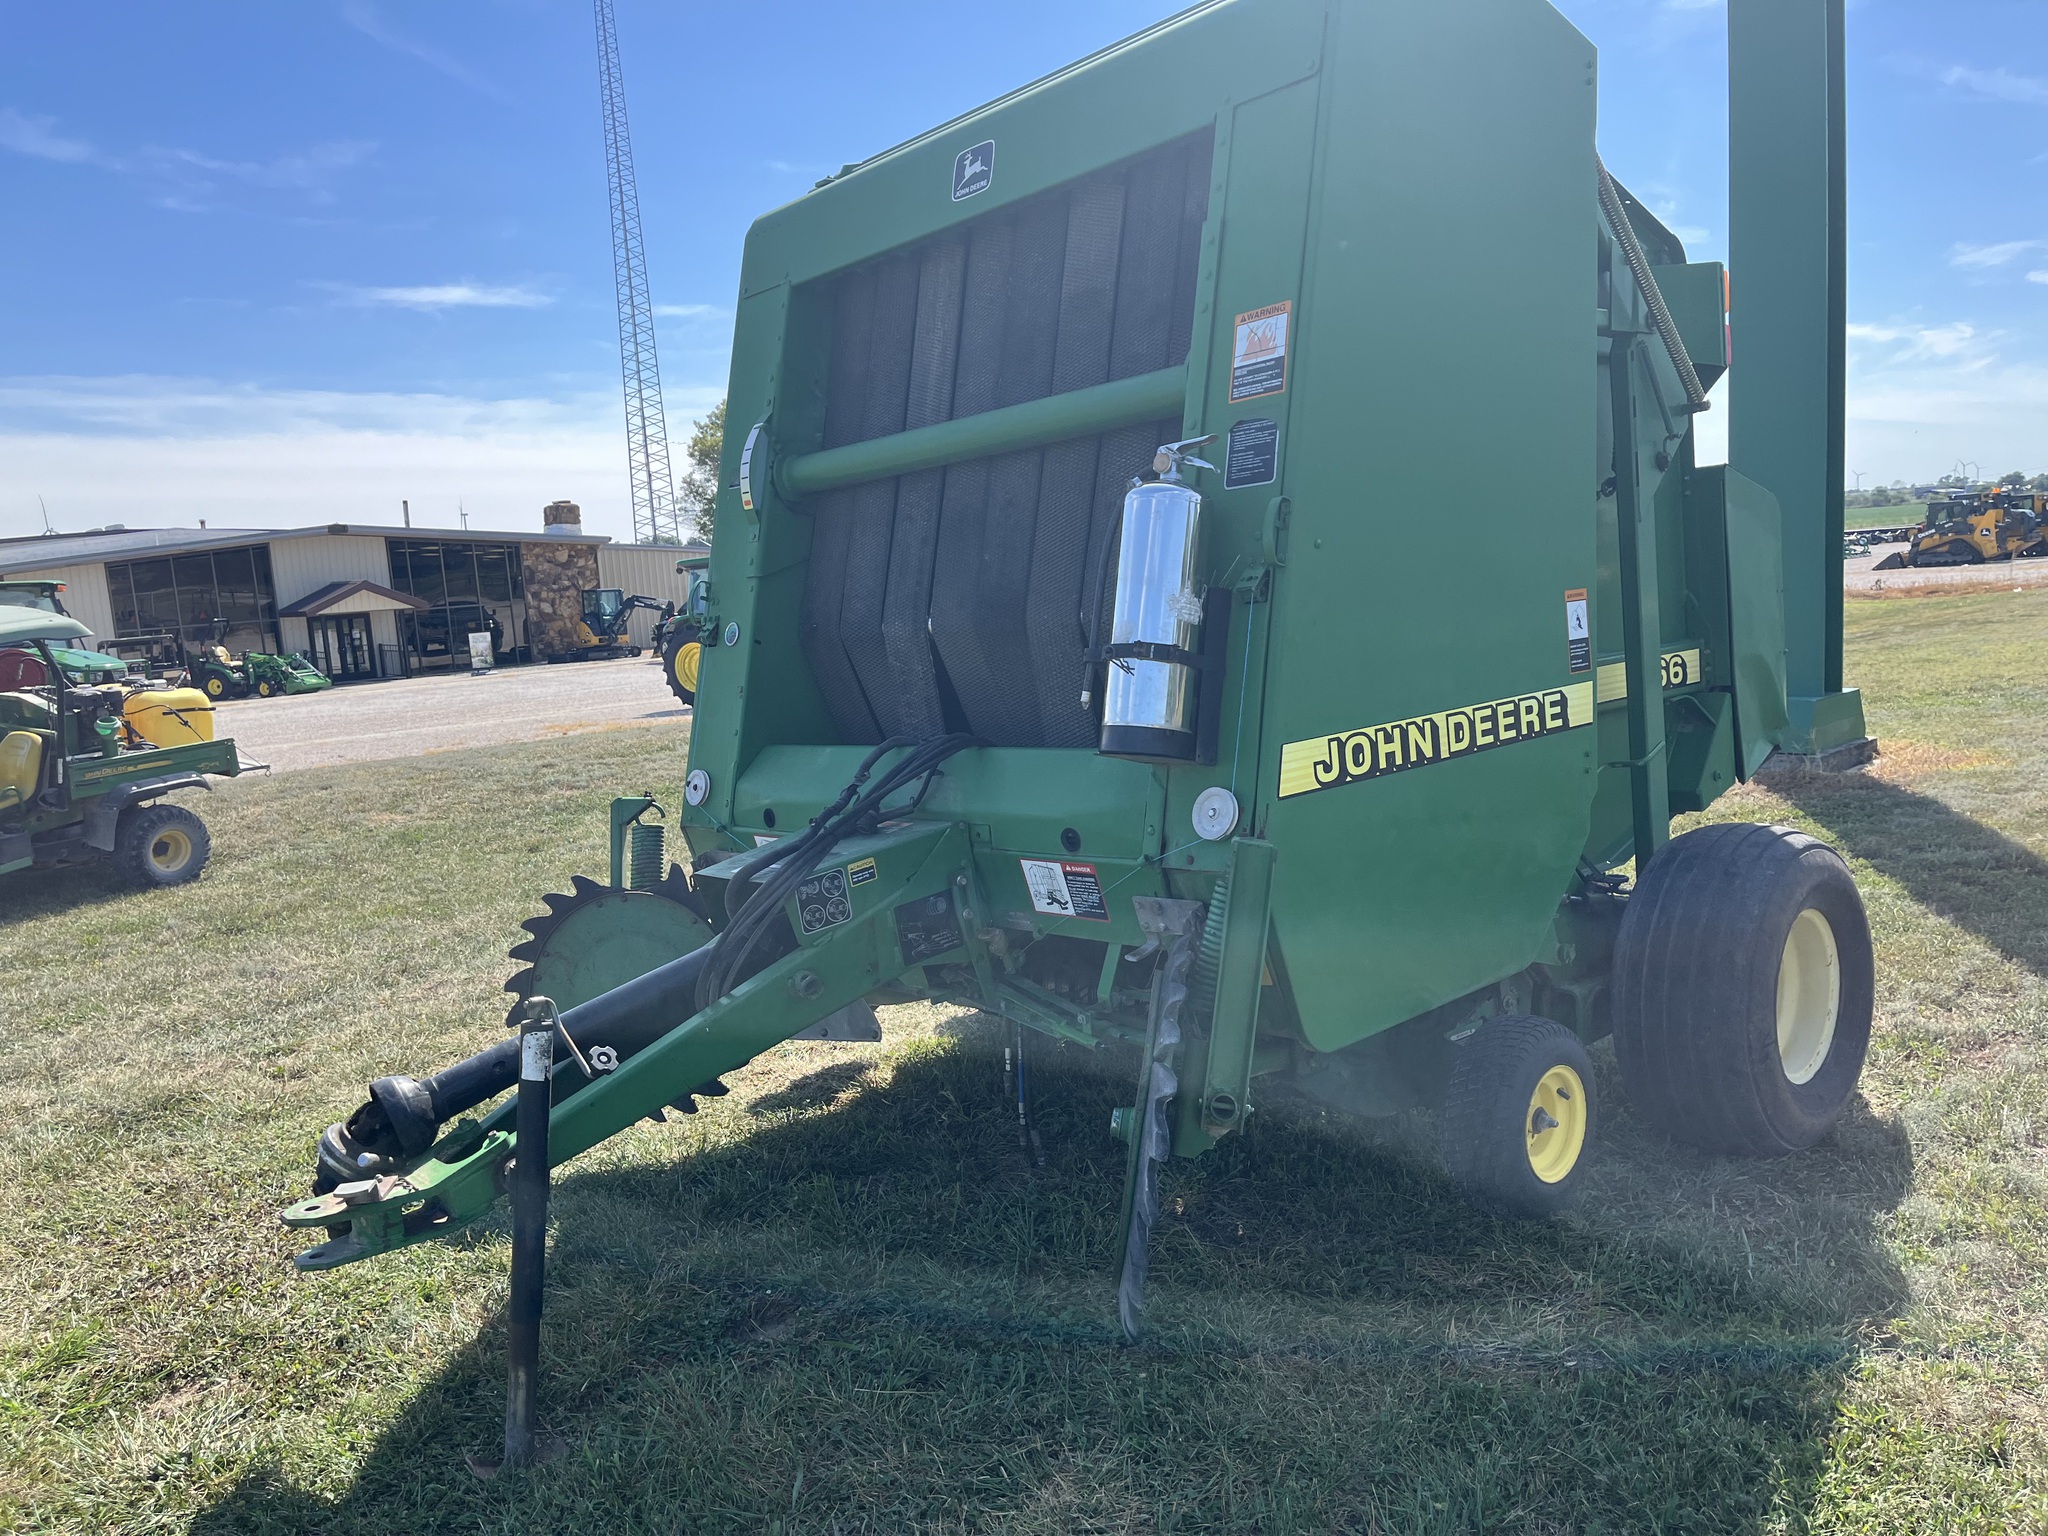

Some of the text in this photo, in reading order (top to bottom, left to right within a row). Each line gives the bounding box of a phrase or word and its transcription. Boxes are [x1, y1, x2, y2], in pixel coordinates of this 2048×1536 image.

[955, 179, 988, 198] JOHN DEERE
[1247, 304, 1286, 321] WARNING
[1314, 690, 1568, 785] JOHN DEERE
